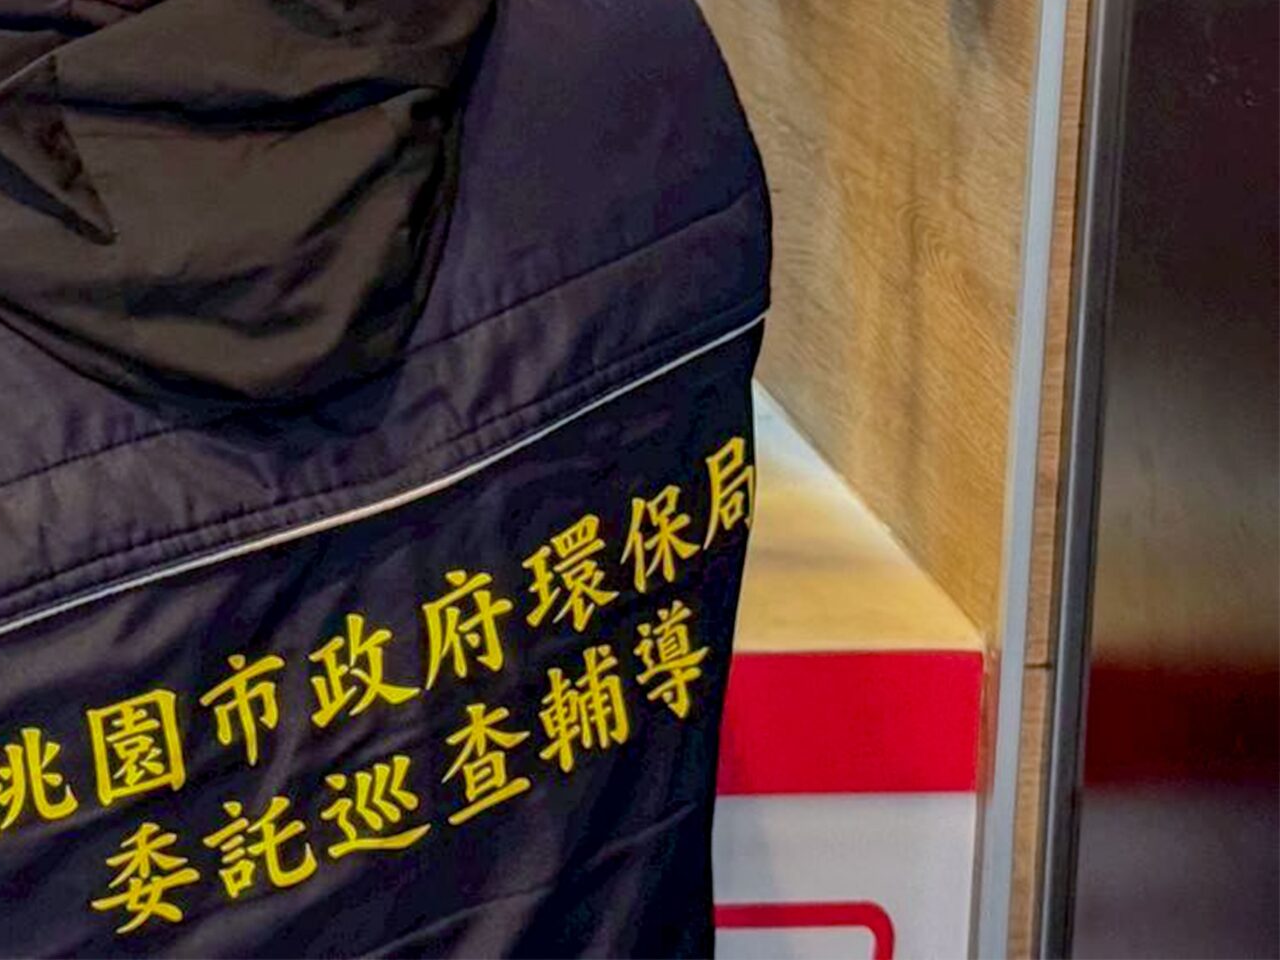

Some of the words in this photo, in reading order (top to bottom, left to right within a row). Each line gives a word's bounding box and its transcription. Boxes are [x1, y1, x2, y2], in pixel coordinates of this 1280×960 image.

[91, 607, 710, 934] 委託巡查輔導
